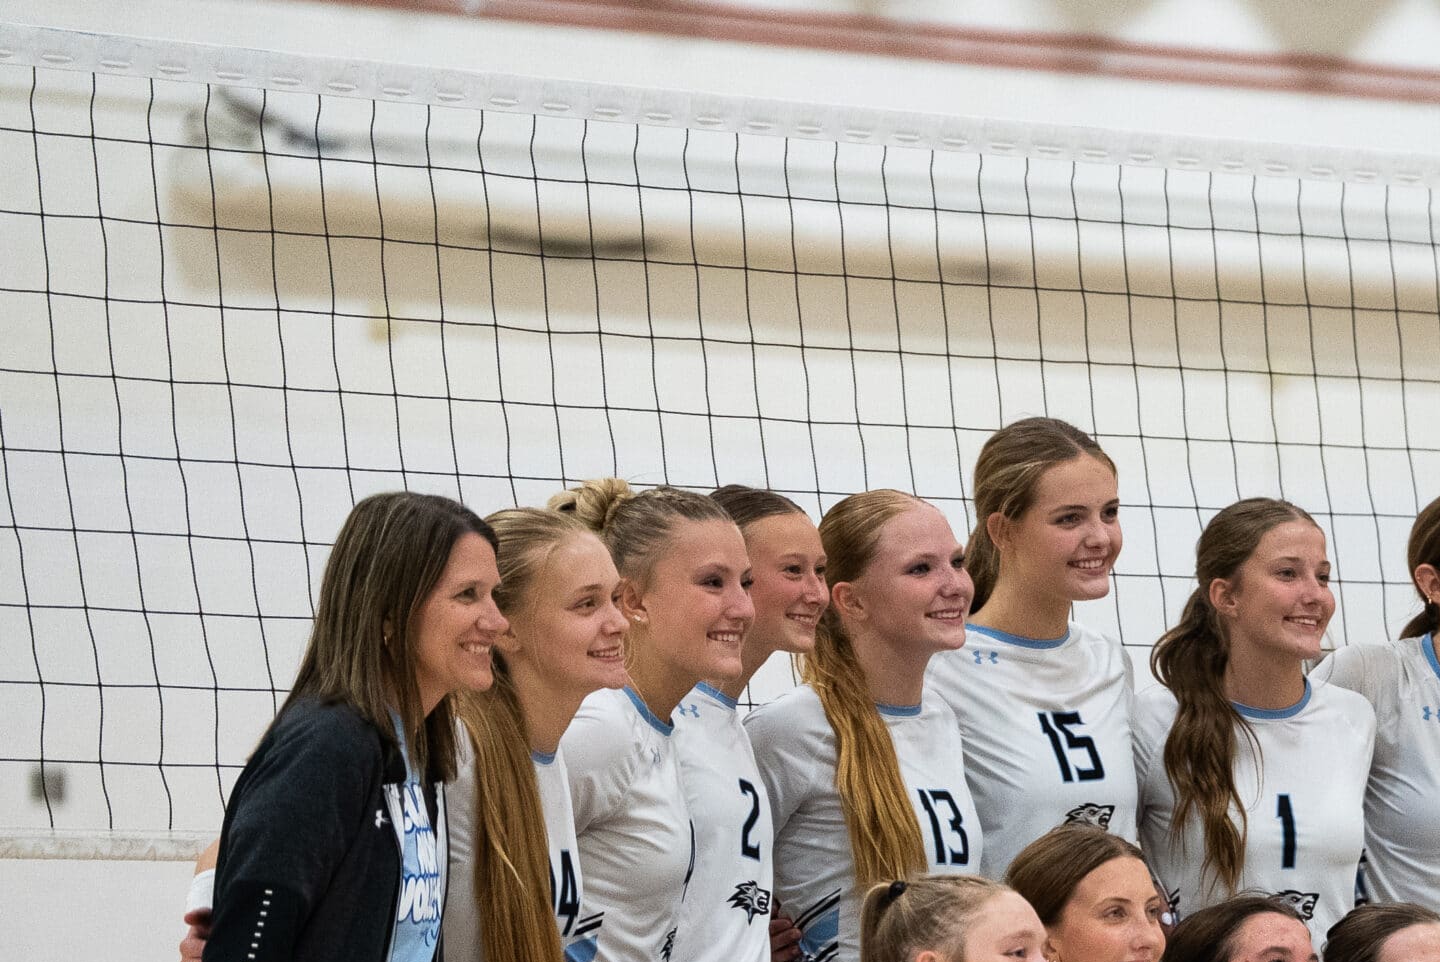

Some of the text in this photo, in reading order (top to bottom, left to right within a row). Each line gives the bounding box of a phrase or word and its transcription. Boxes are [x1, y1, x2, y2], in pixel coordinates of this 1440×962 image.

[1037, 711, 1105, 783] 15
[738, 778, 761, 862] 2
[917, 789, 969, 866] 13
[1277, 793, 1296, 869] 1
[549, 849, 580, 938] 4
